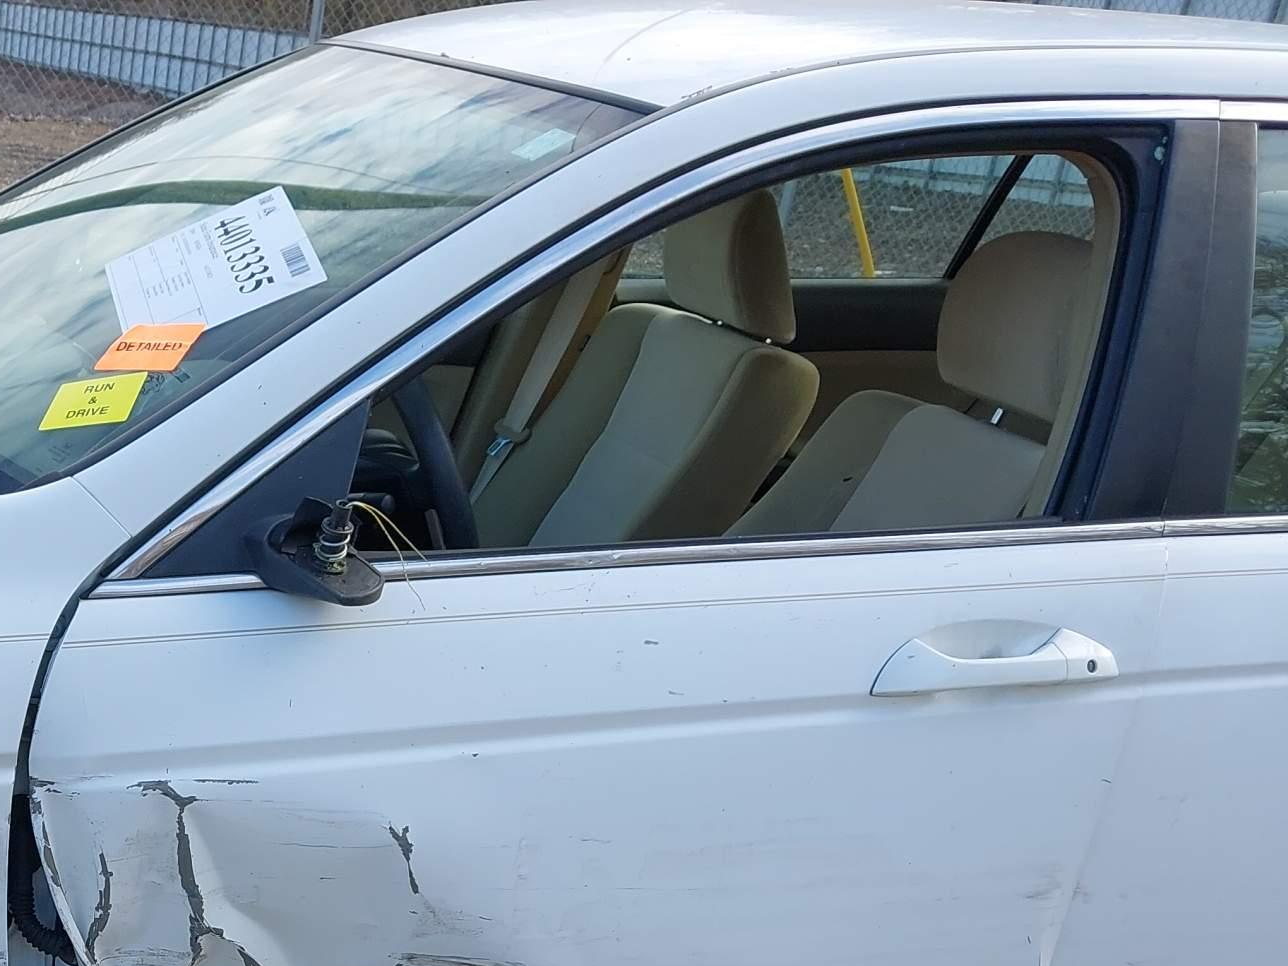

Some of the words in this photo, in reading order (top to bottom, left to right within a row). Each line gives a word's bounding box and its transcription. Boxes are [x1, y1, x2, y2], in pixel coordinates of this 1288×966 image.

[214, 215, 275, 294] 44013335
[116, 341, 182, 352] DETAILED
[84, 383, 115, 395] RUN
[88, 396, 98, 405] &
[66, 406, 110, 419] DRIVE
